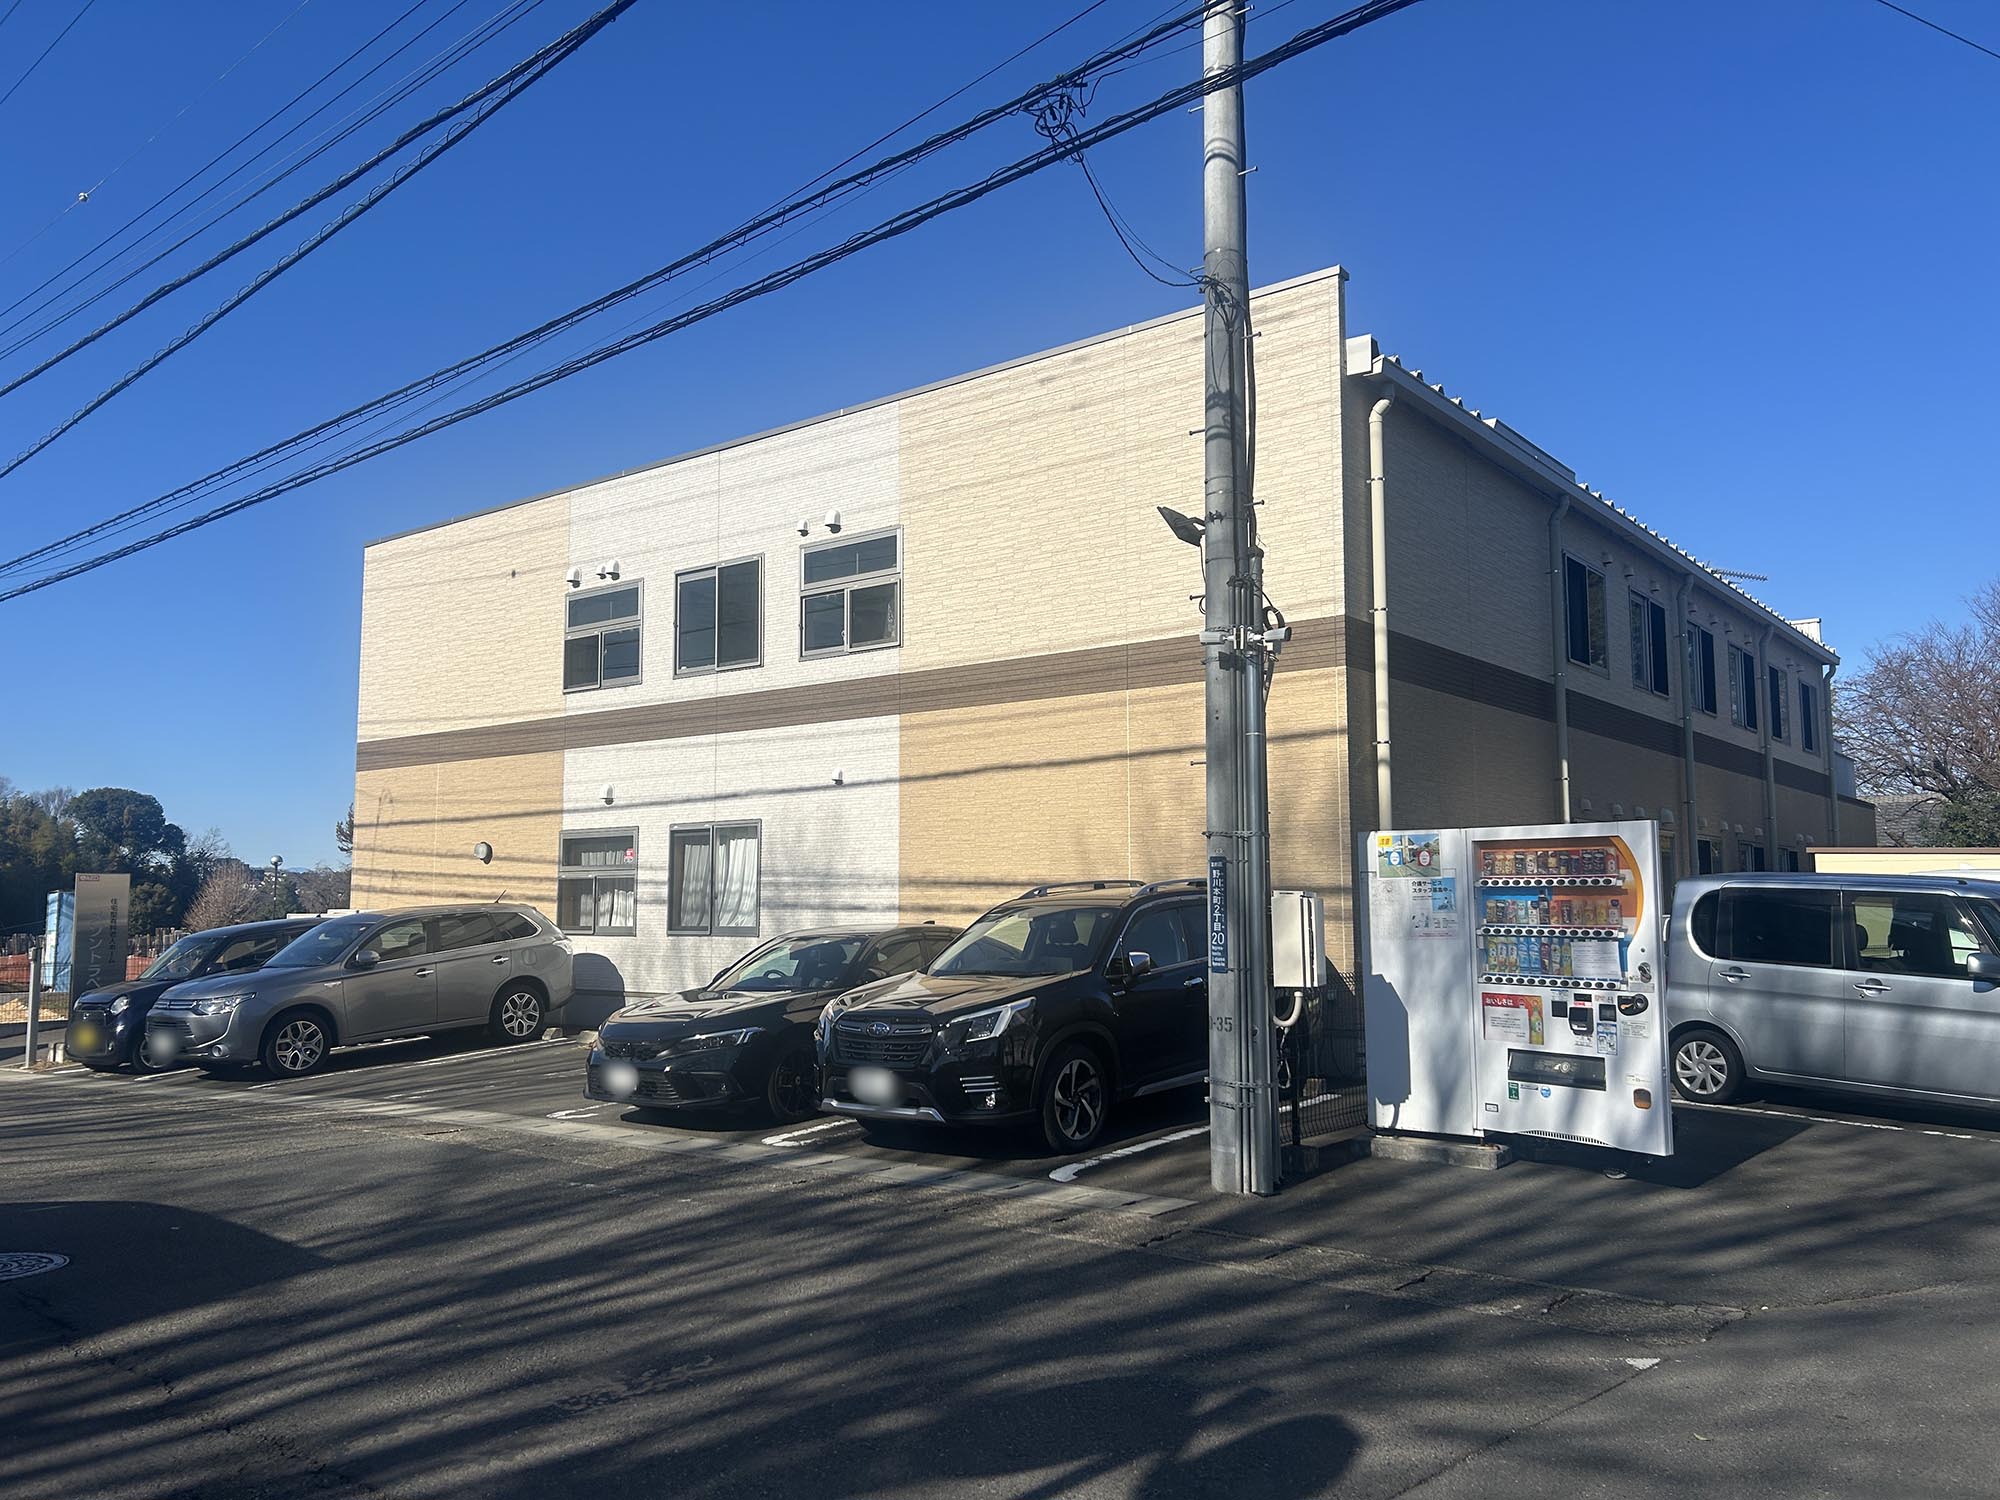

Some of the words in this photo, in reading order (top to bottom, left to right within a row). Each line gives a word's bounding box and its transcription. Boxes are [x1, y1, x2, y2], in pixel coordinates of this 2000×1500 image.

[1212, 869, 1222, 932] 野川本町2丁目
[1211, 932, 1225, 945] 20
